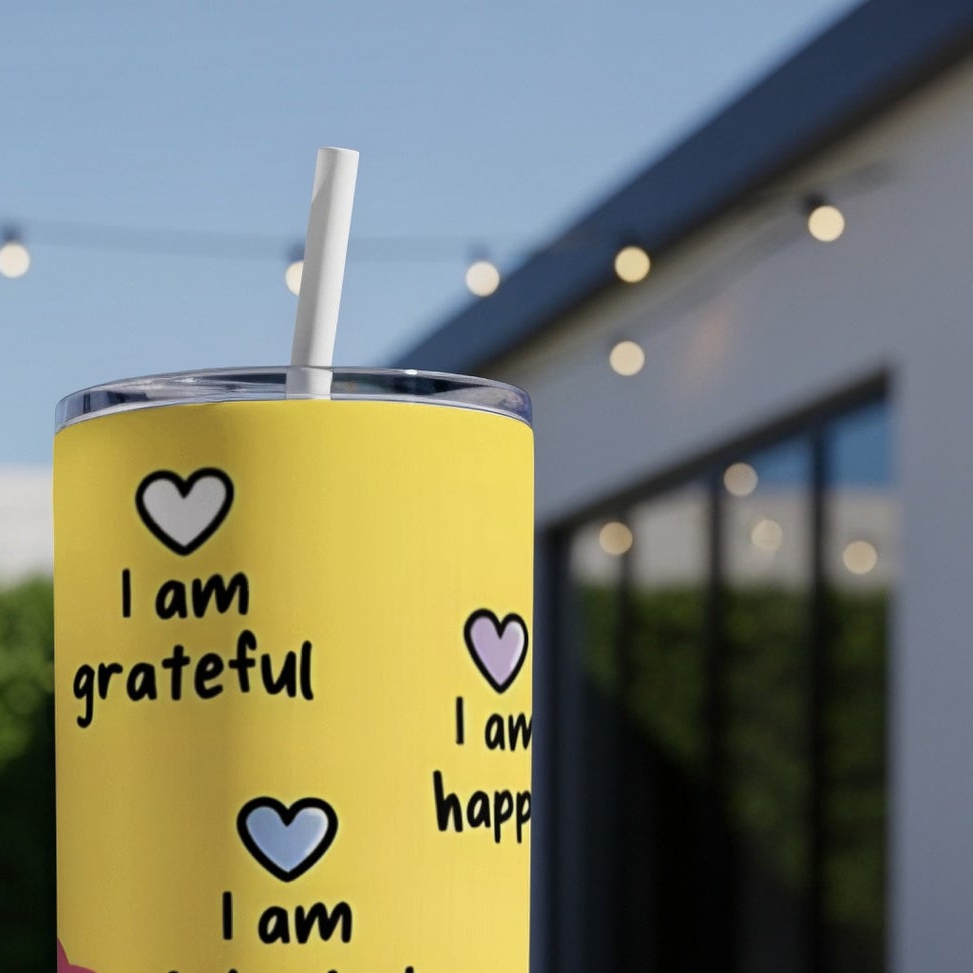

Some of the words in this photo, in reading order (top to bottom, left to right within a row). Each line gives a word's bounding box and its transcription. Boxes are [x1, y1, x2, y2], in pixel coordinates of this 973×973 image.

[123, 568, 131, 618] I
[155, 572, 249, 620] am
[73, 629, 314, 729] grateful
[456, 696, 464, 745] I
[223, 891, 232, 941] I
[257, 901, 353, 945] am
